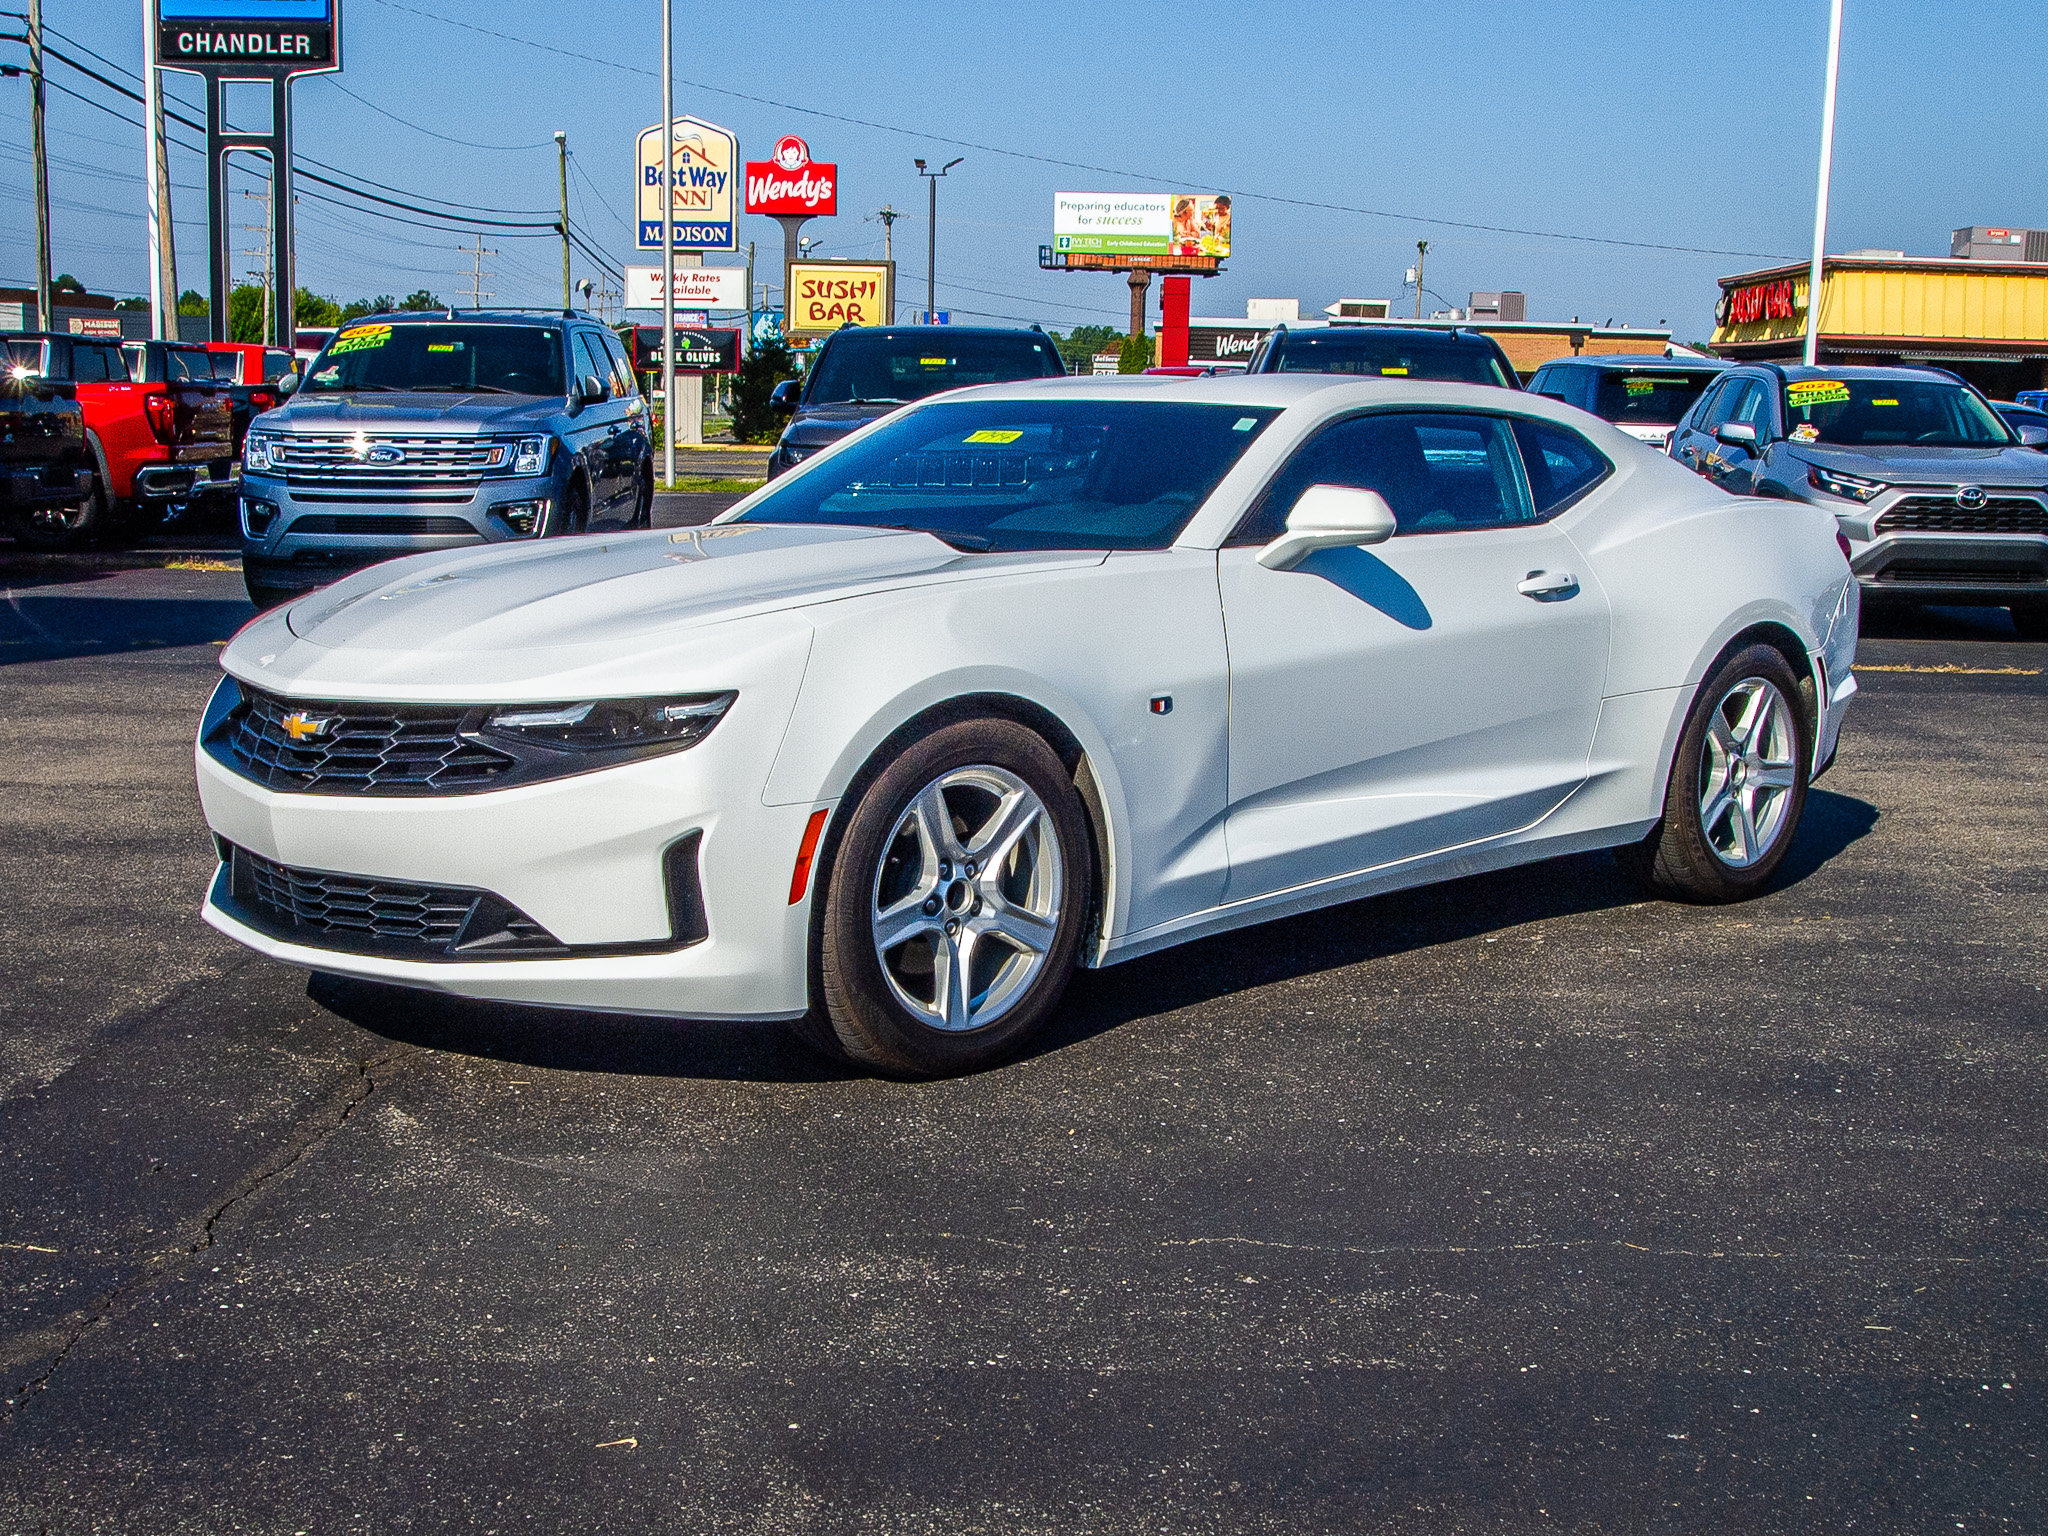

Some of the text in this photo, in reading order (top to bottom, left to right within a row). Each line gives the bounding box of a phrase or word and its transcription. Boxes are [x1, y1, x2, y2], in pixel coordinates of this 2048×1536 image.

[178, 33, 310, 54] CHANDLER
[688, 166, 728, 194] Way
[748, 169, 833, 207] Wendy's
[672, 190, 707, 206] NN
[1060, 201, 1166, 213] Preparing educators
[1078, 214, 1143, 226] for success
[644, 225, 728, 242] MDISON
[692, 273, 721, 282] Rates
[801, 280, 876, 299] SUSHI
[809, 301, 866, 322] BAR
[1216, 332, 1259, 357] Wend
[650, 351, 721, 363] BLK OLIVES
[1795, 382, 1836, 390] 2025
[369, 451, 393, 460] Ford
